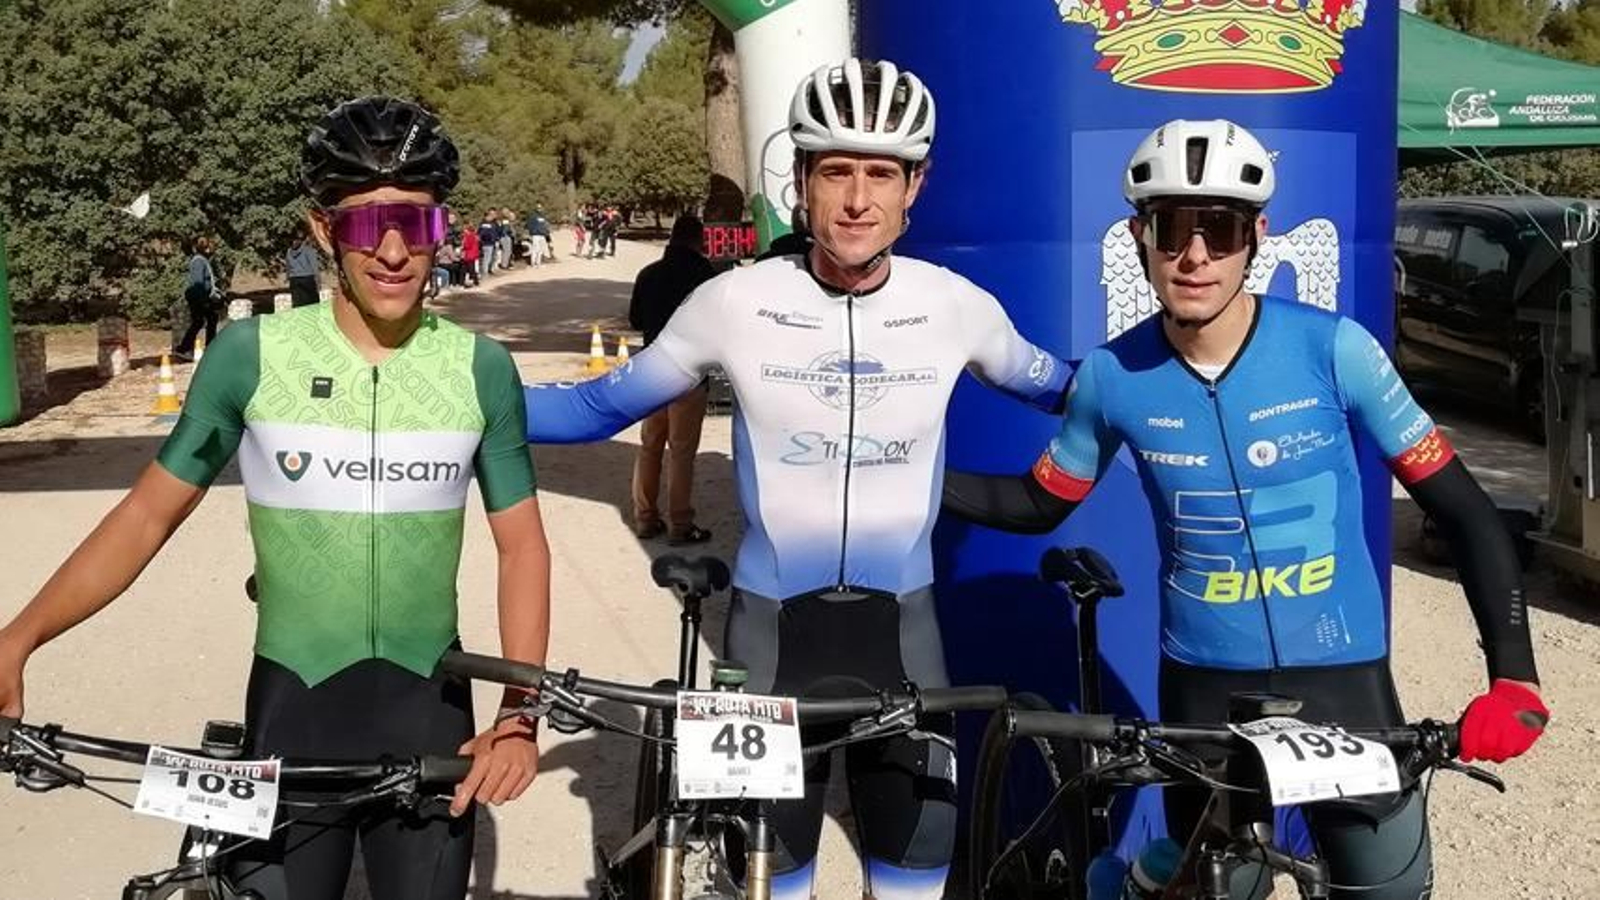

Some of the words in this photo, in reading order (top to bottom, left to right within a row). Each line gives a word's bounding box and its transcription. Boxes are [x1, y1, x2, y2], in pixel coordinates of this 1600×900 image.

[1508, 105, 1570, 115] ANDALUZA
[1248, 397, 1319, 422] BONTRAGER
[1147, 416, 1185, 429] mobel
[322, 457, 461, 482] vellsam
[1138, 449, 1210, 467] TREK
[711, 723, 767, 761] 48
[1274, 731, 1365, 761] 193
[168, 770, 255, 800] 108
